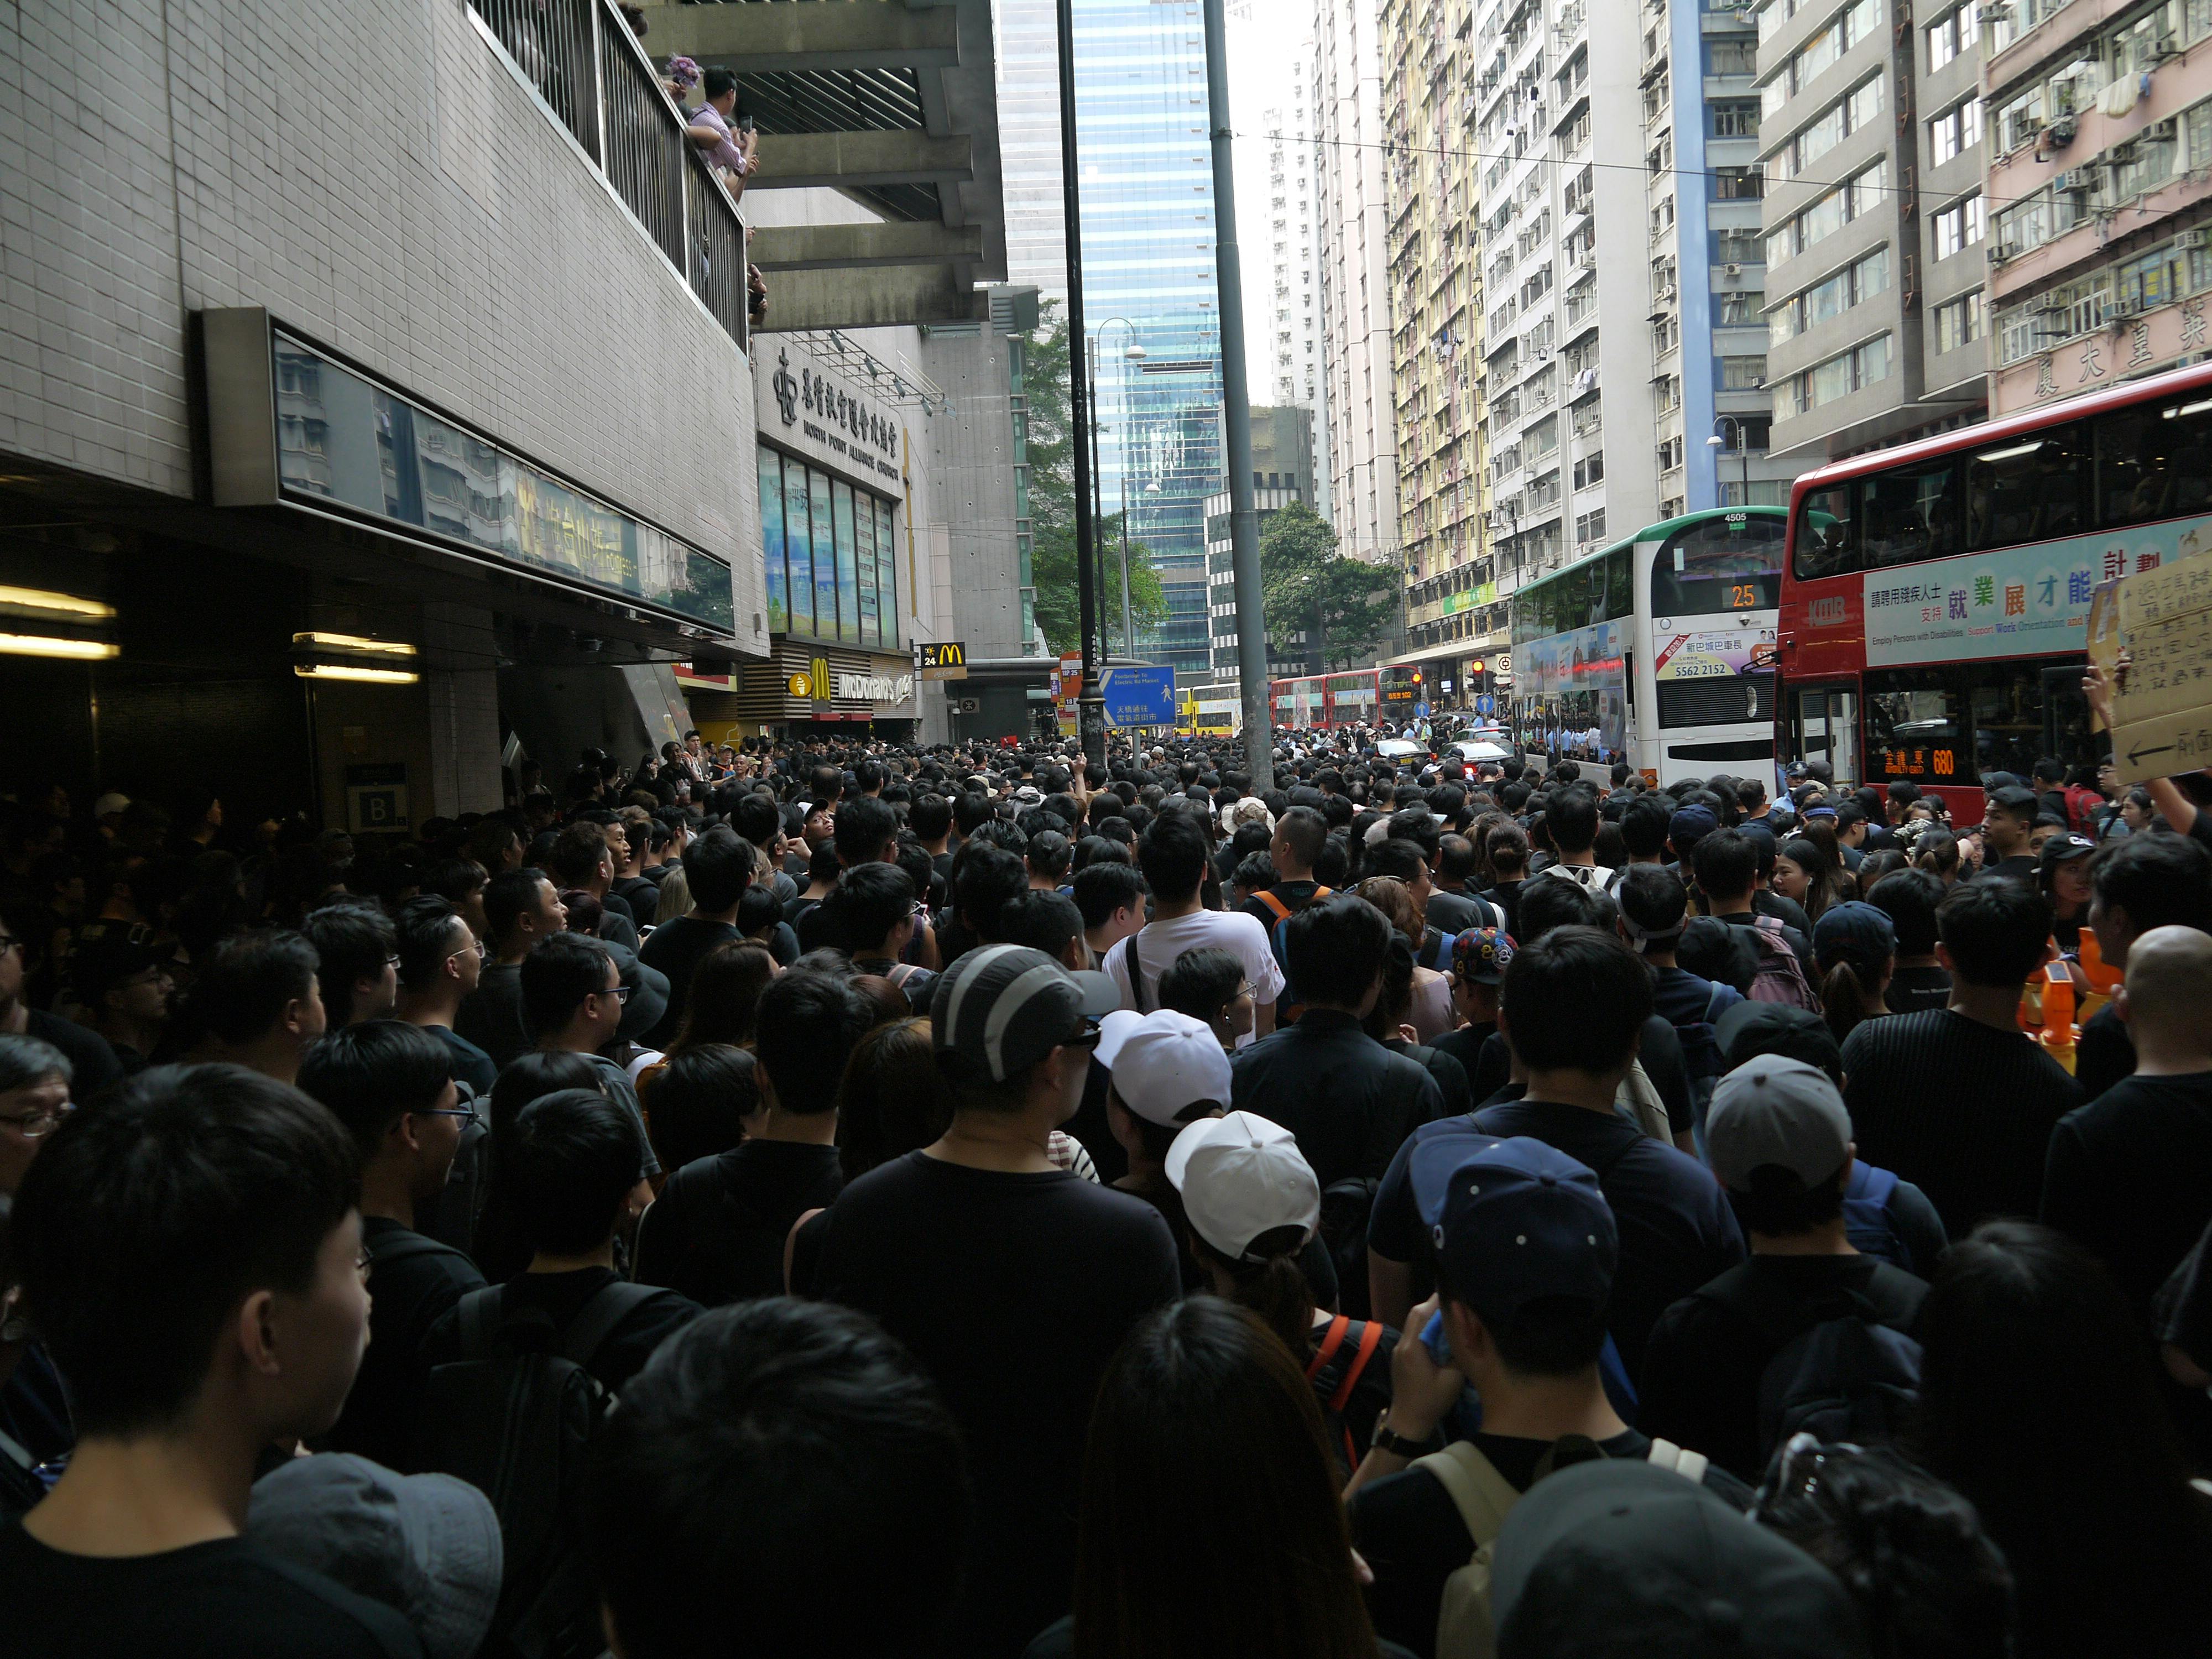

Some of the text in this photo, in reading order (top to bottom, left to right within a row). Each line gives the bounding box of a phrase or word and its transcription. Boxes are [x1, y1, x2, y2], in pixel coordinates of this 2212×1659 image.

[804, 419, 899, 481] NORTH POINT ALLIANCE CHURCH
[1725, 513, 1746, 521] 4505
[1731, 585, 1756, 607] 25
[1871, 582, 1942, 608] 請聘用殘疾人士
[1809, 596, 1845, 628] KMB
[1921, 606, 1942, 623] 支持
[1872, 637, 1892, 646] Employ
[1931, 629, 1963, 639] Disabilities
[1968, 627, 1994, 636] Support
[1995, 623, 2016, 633] Work
[2019, 619, 2065, 632] Orientation
[2067, 615, 2083, 627] and
[1676, 664, 1725, 677] 5562 2152
[839, 674, 894, 700] McDonald's
[1933, 749, 1954, 775] 680
[371, 797, 386, 821] B
